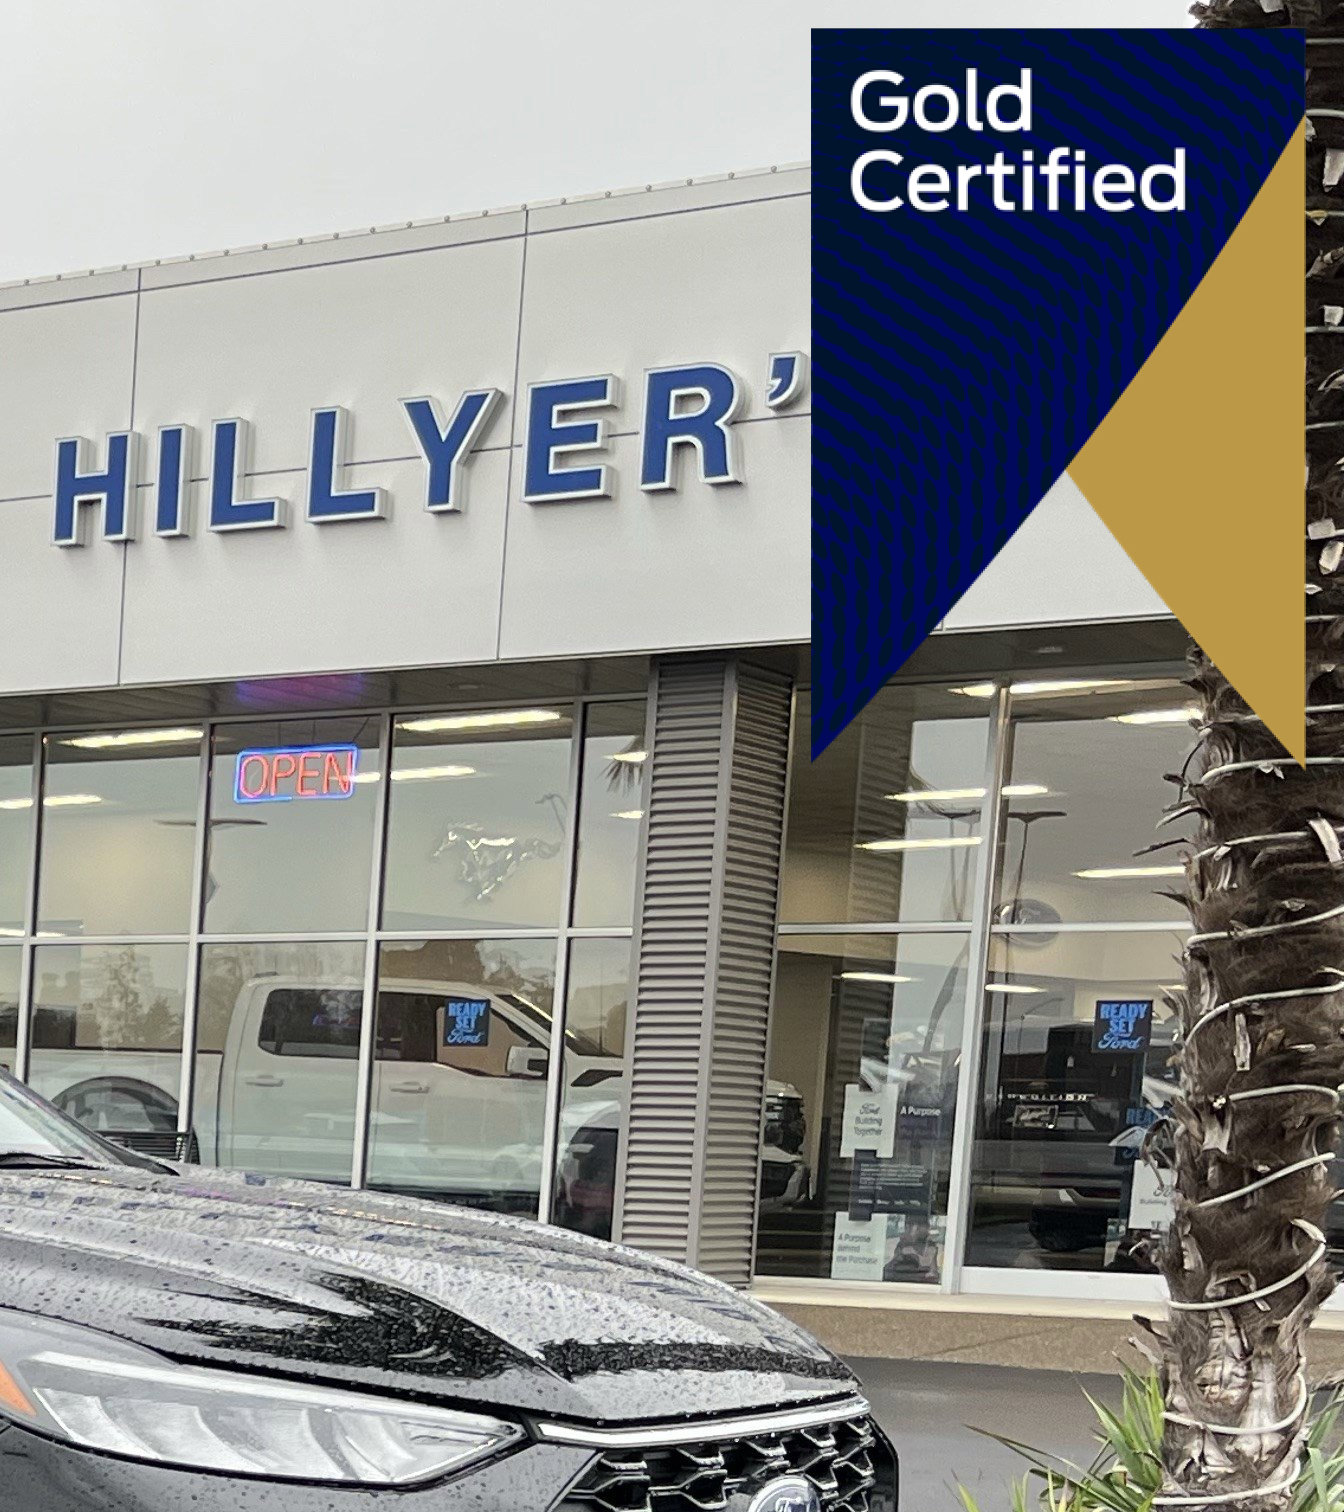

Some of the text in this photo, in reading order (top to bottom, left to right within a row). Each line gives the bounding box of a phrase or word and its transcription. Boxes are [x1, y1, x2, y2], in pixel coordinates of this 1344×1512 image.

[52, 350, 809, 548] HILLYER'
[239, 752, 354, 798] OPEN
[448, 1002, 487, 1017] READY
[1100, 1003, 1148, 1019] READY
[455, 1016, 477, 1030] SET
[1109, 1018, 1137, 1034] SET
[1098, 1033, 1147, 1050] Ford
[900, 1105, 942, 1117] A Purpose
